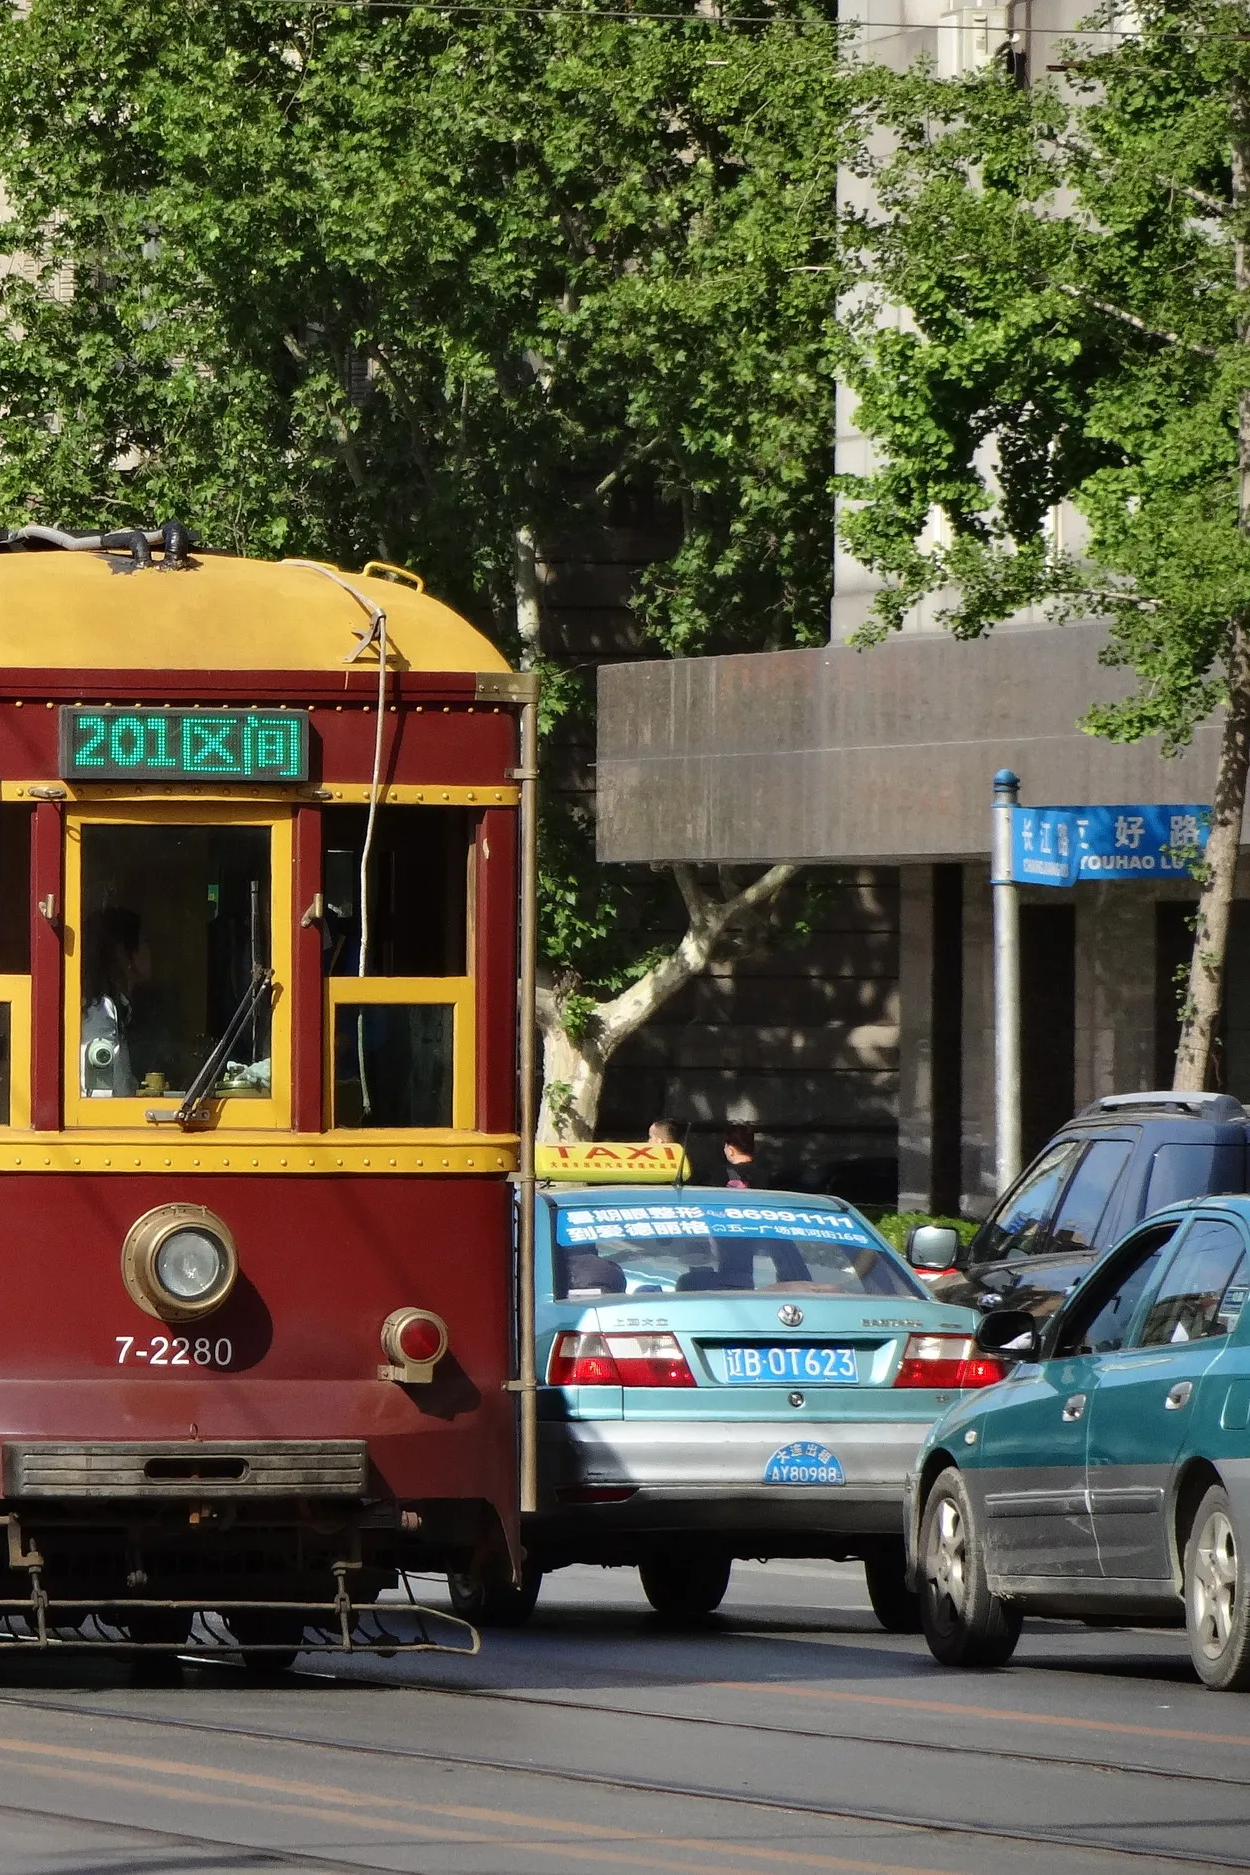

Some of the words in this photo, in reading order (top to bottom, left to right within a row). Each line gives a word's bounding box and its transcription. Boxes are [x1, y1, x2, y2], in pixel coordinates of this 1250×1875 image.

[75, 716, 300, 775] 201区间
[546, 1146, 676, 1160] TAXI
[725, 1207, 854, 1229] 86991111
[115, 1336, 232, 1365] 7-2280
[771, 1466, 837, 1483] AY80988
